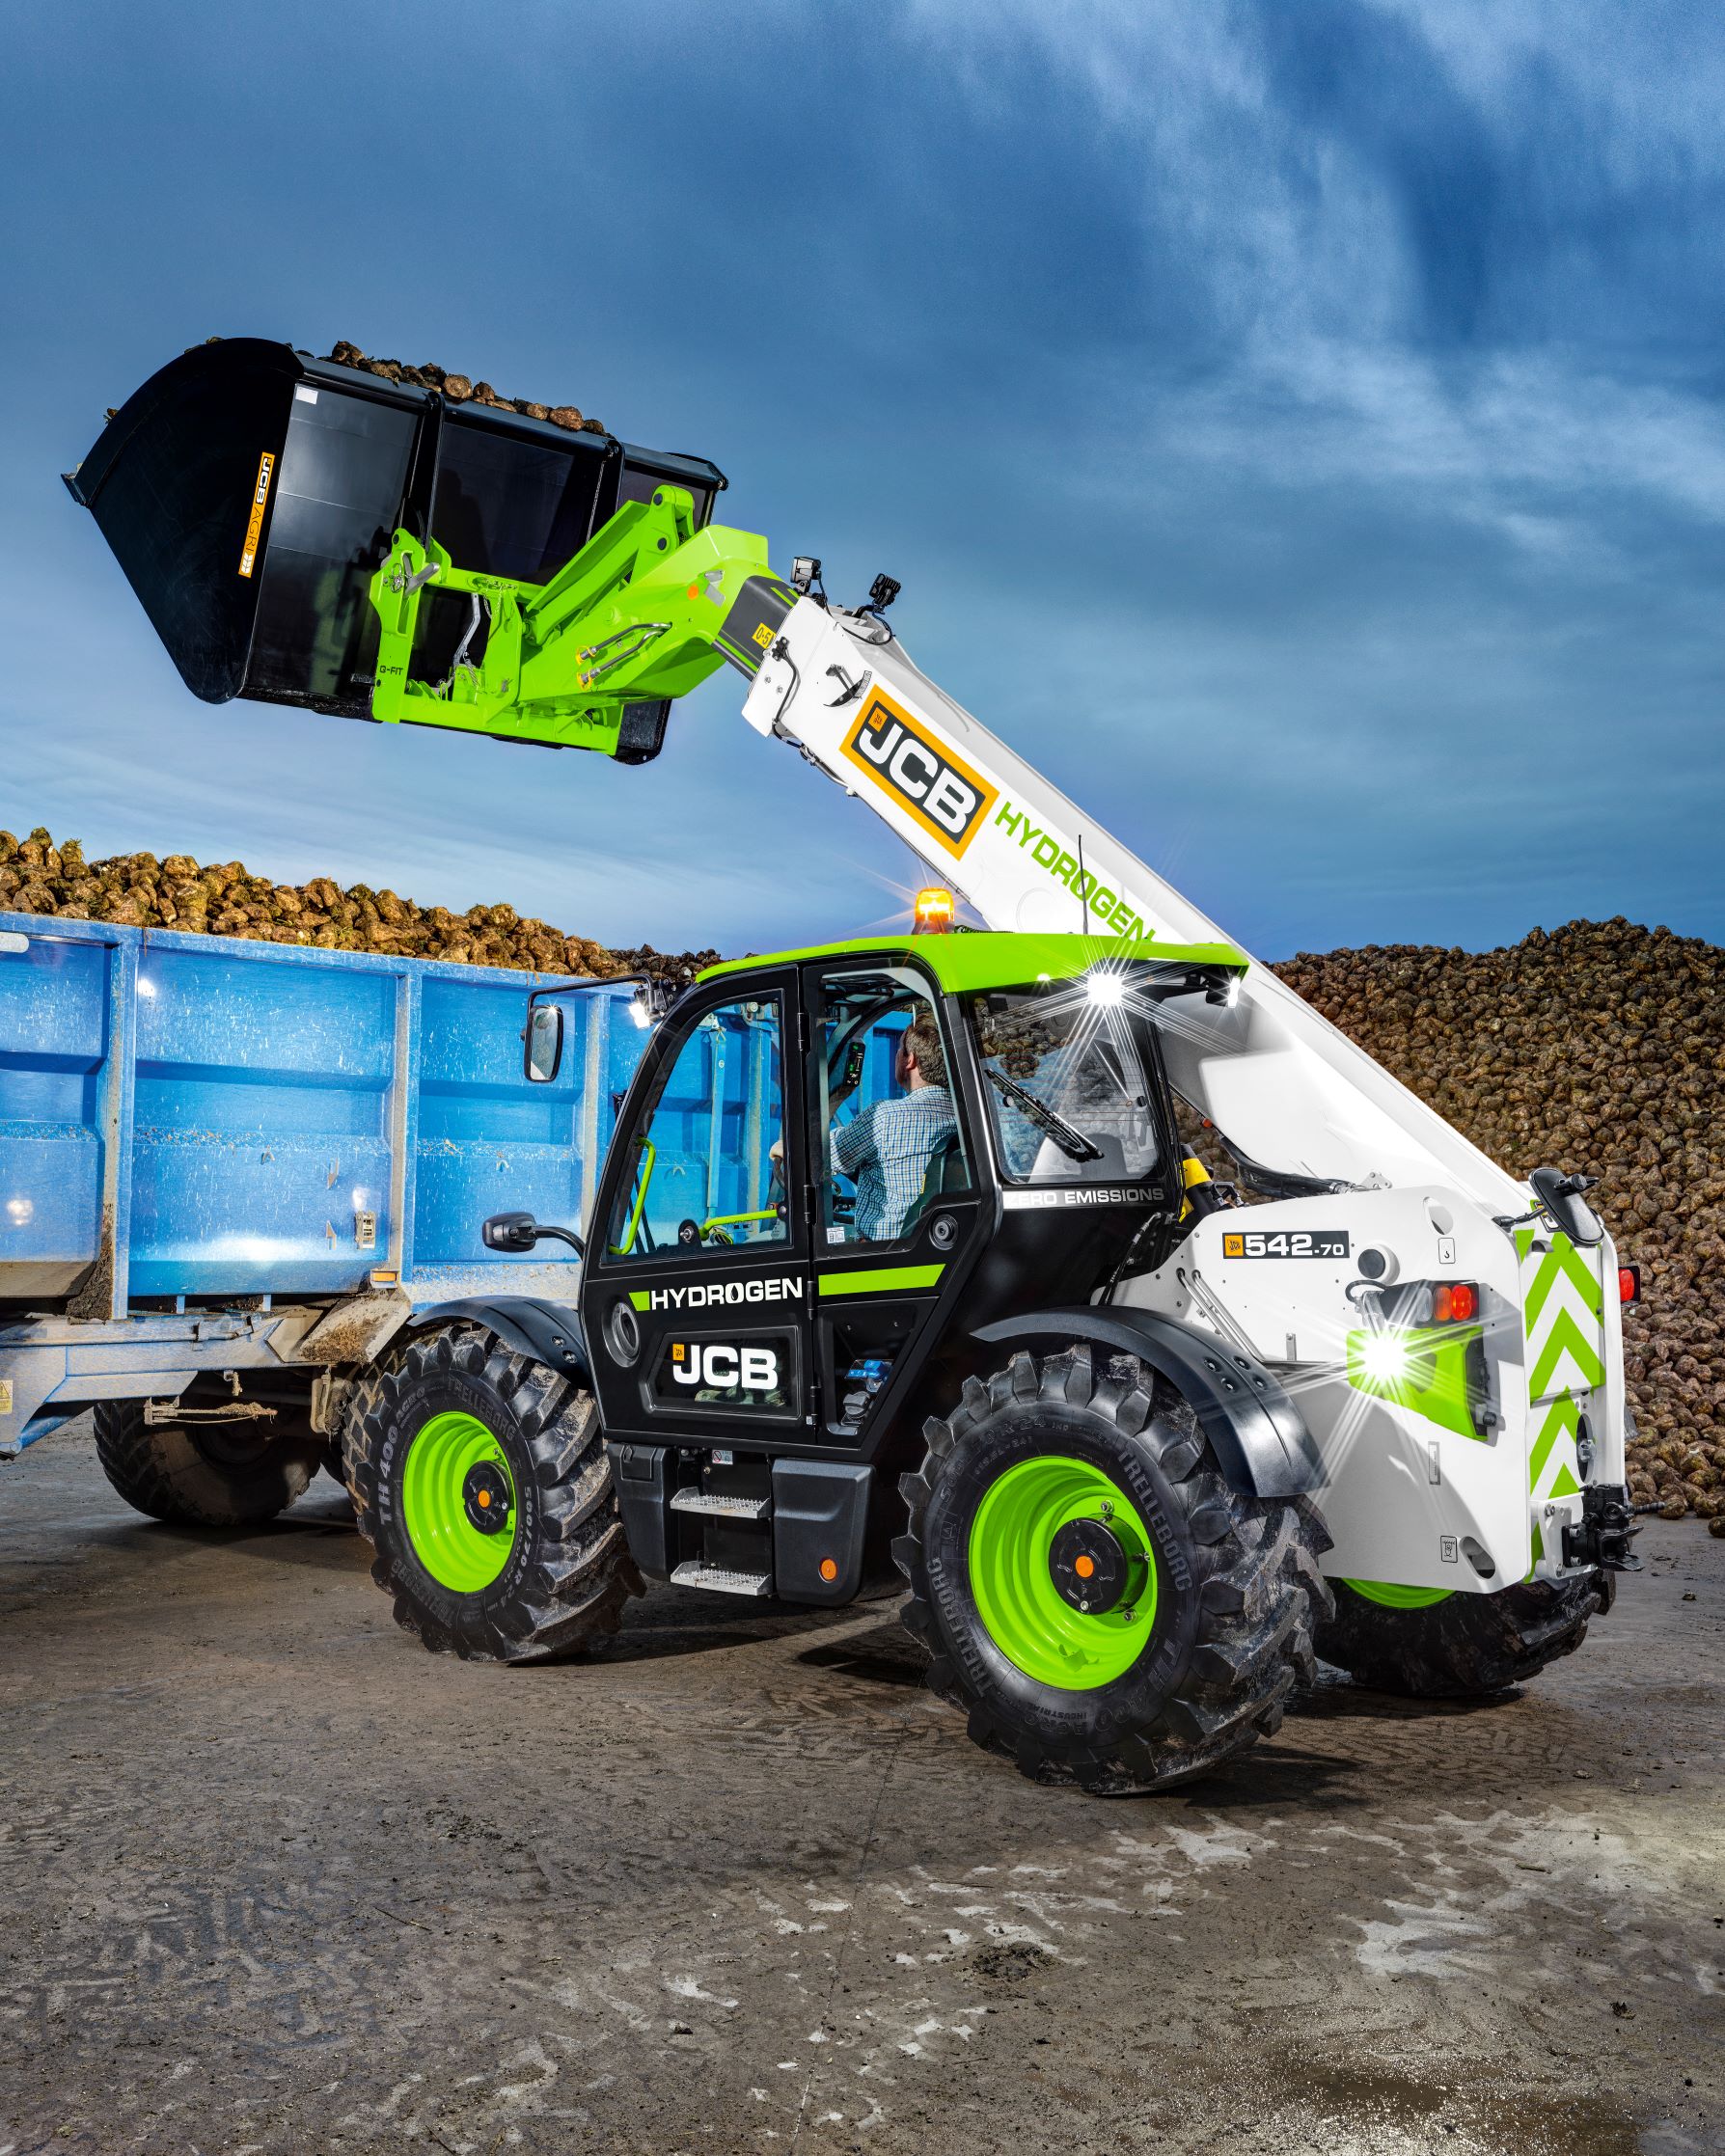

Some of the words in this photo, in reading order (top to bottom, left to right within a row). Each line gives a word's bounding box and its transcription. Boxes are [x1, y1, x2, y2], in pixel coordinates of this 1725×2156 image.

[256, 456, 271, 505] JCB
[245, 506, 262, 552] AGRI
[379, 665, 404, 675] Q-FIT
[858, 722, 977, 834] JCB
[994, 800, 1157, 942] HYDROGEN
[1064, 1187, 1164, 1205] EMISSIONS
[1245, 1234, 1346, 1257] 542-70
[651, 1276, 804, 1311] HYDROGEN
[672, 1345, 779, 1390] JCB
[1117, 1450, 1193, 1593] TRELLEBORG
[926, 1556, 997, 1699] TRELLEBORG
